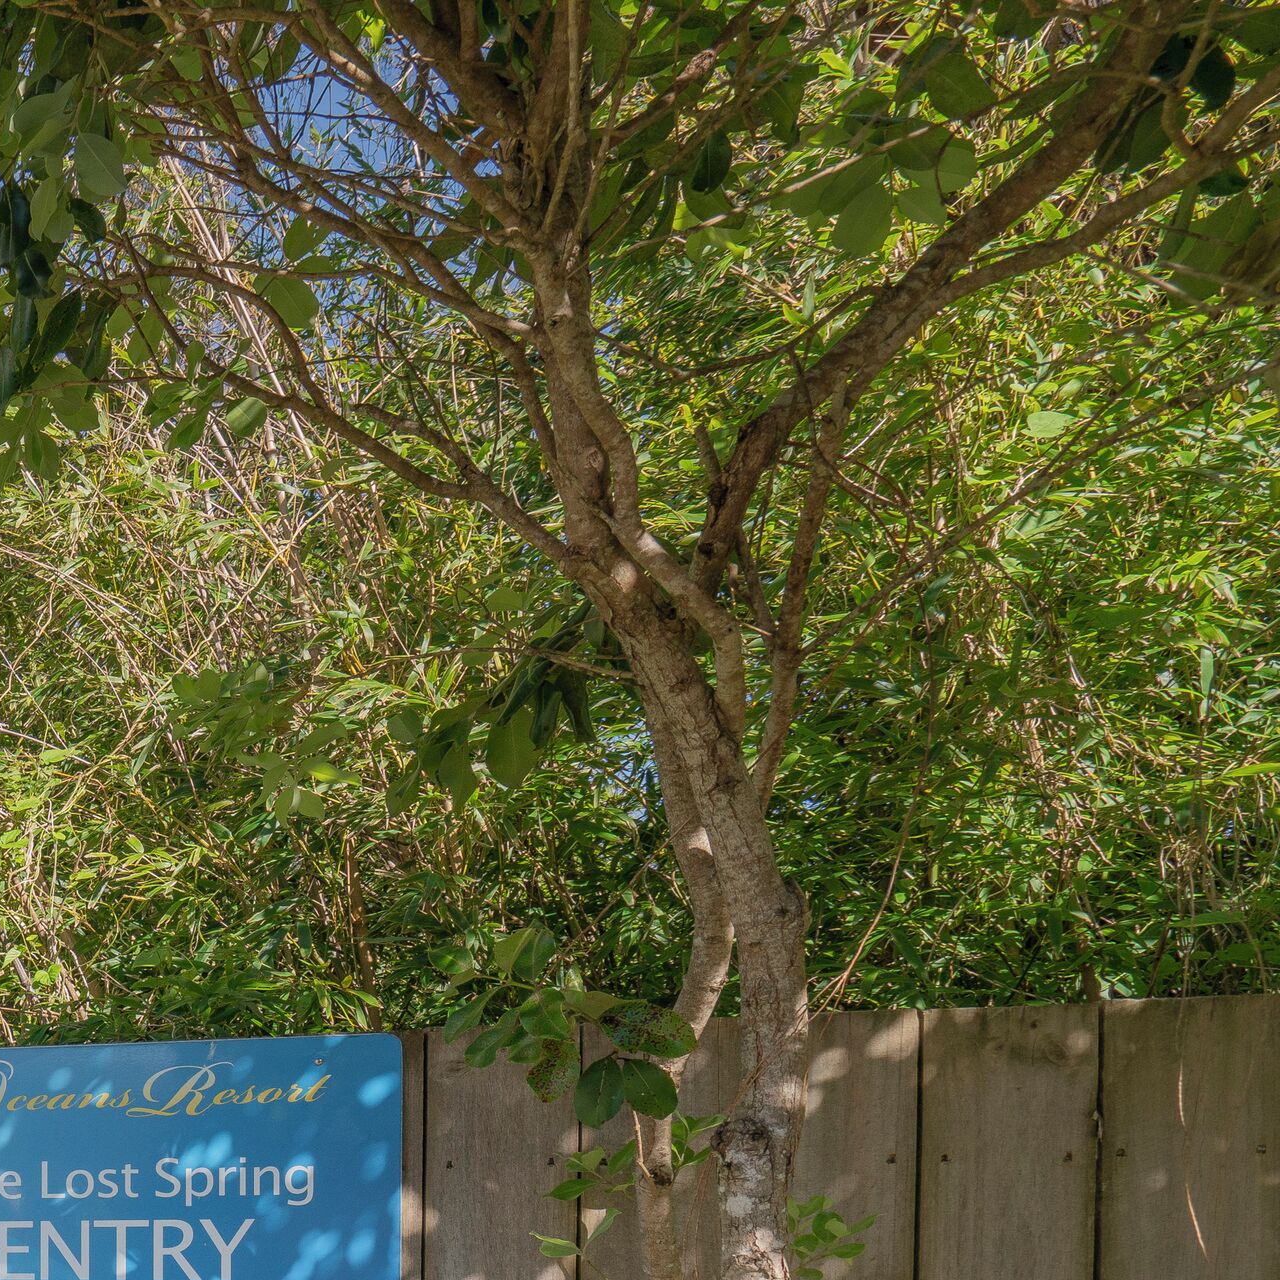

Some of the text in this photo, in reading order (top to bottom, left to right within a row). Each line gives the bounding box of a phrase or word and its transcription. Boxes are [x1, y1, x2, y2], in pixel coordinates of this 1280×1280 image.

[126, 1061, 331, 1118] Resort
[41, 1160, 139, 1200] Lost
[154, 1157, 316, 1206] Spring
